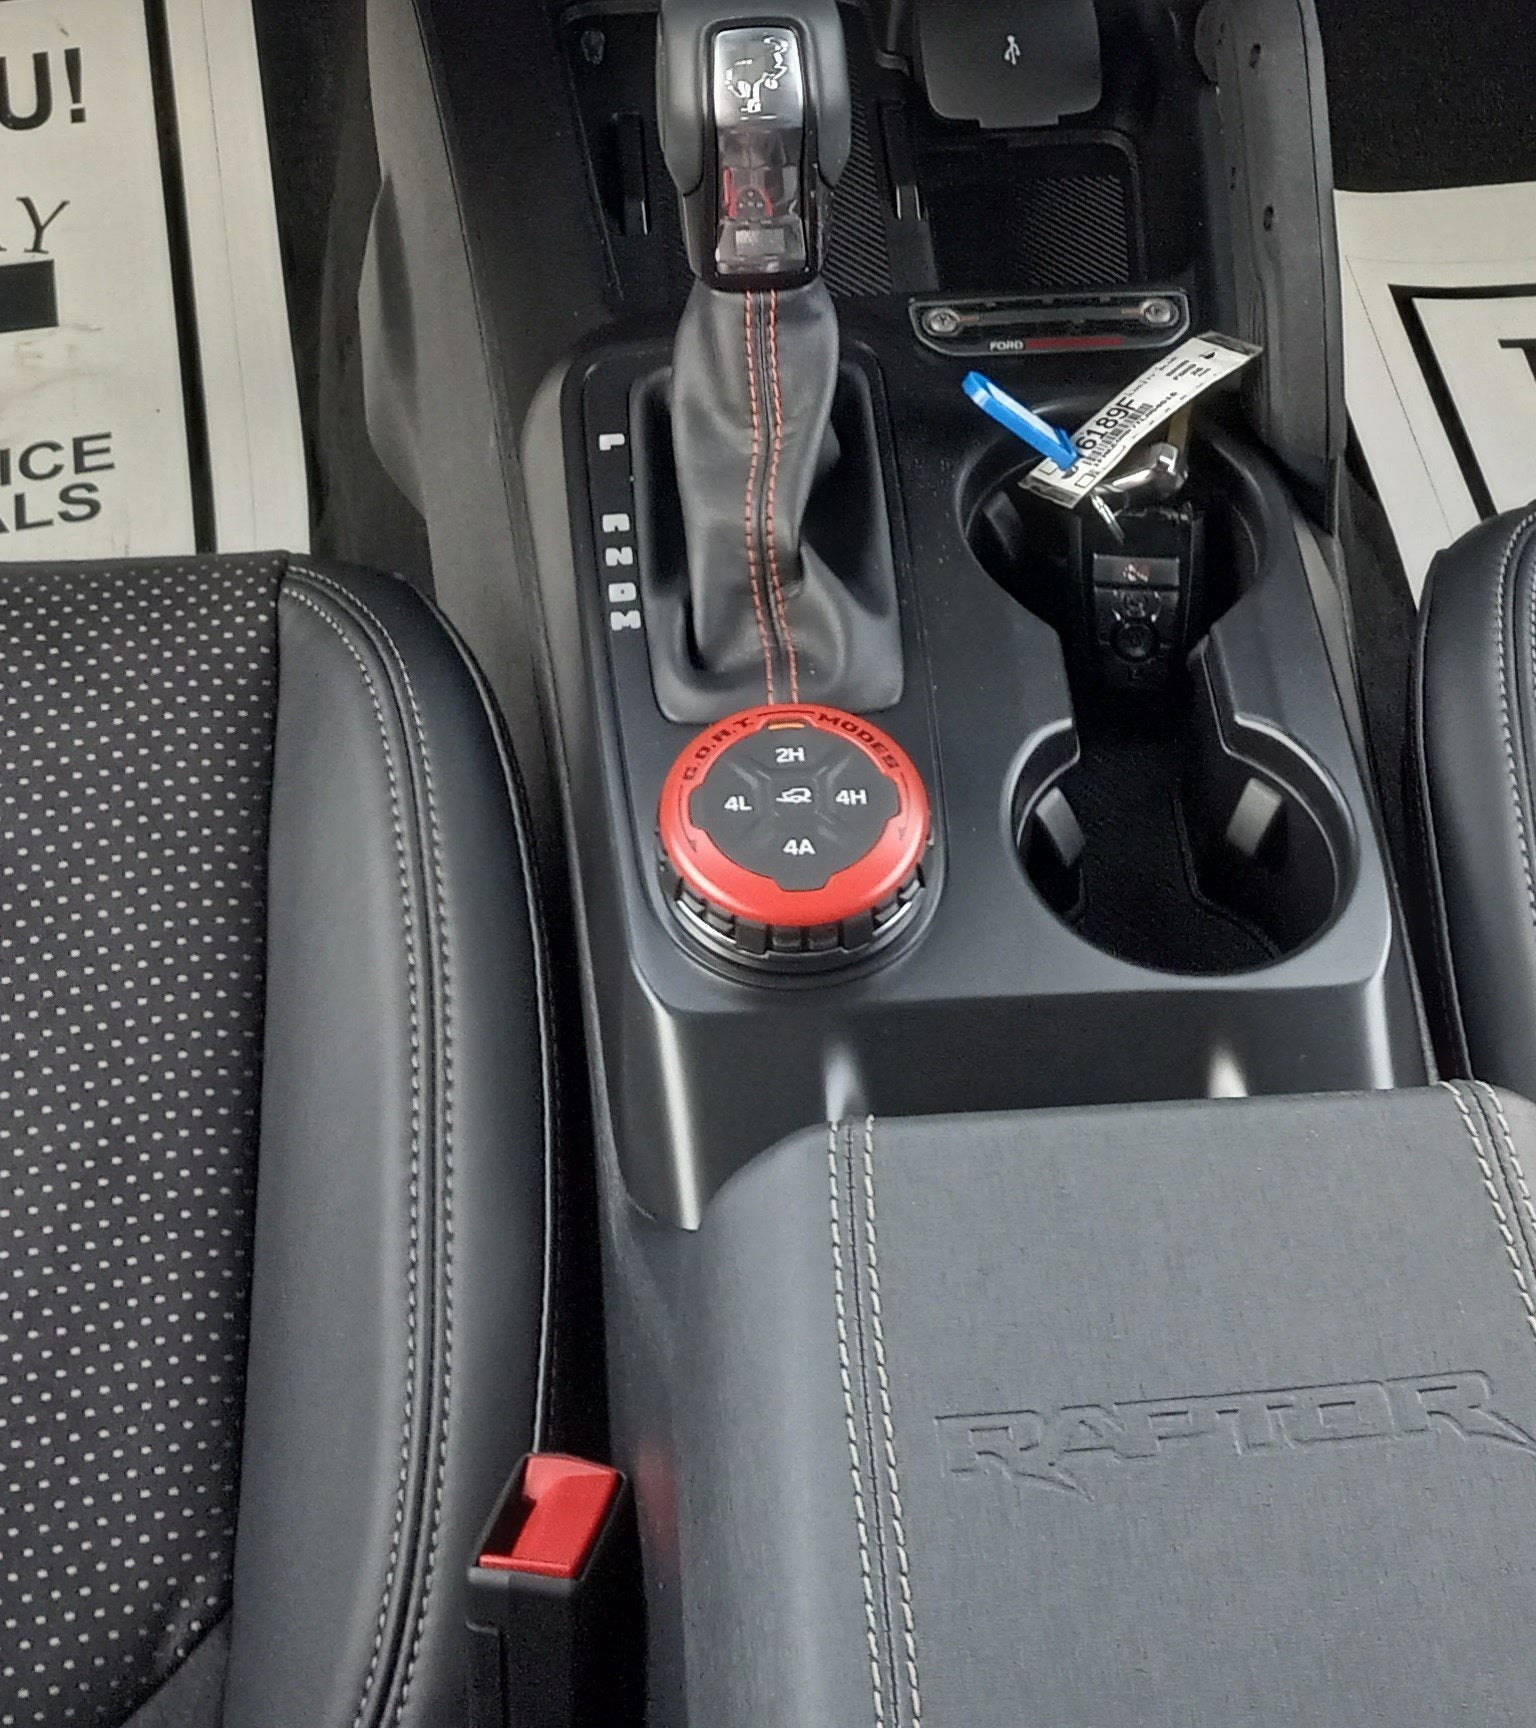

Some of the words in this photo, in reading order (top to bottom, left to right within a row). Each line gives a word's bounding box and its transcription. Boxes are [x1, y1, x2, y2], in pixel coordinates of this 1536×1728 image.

[989, 340, 1024, 351] FORD
[1072, 395, 1139, 456] 6189F
[818, 712, 900, 770] MODES
[775, 747, 805, 763] 2H
[724, 796, 753, 812] 4L
[835, 789, 867, 806] 4H
[783, 839, 816, 855] 4A
